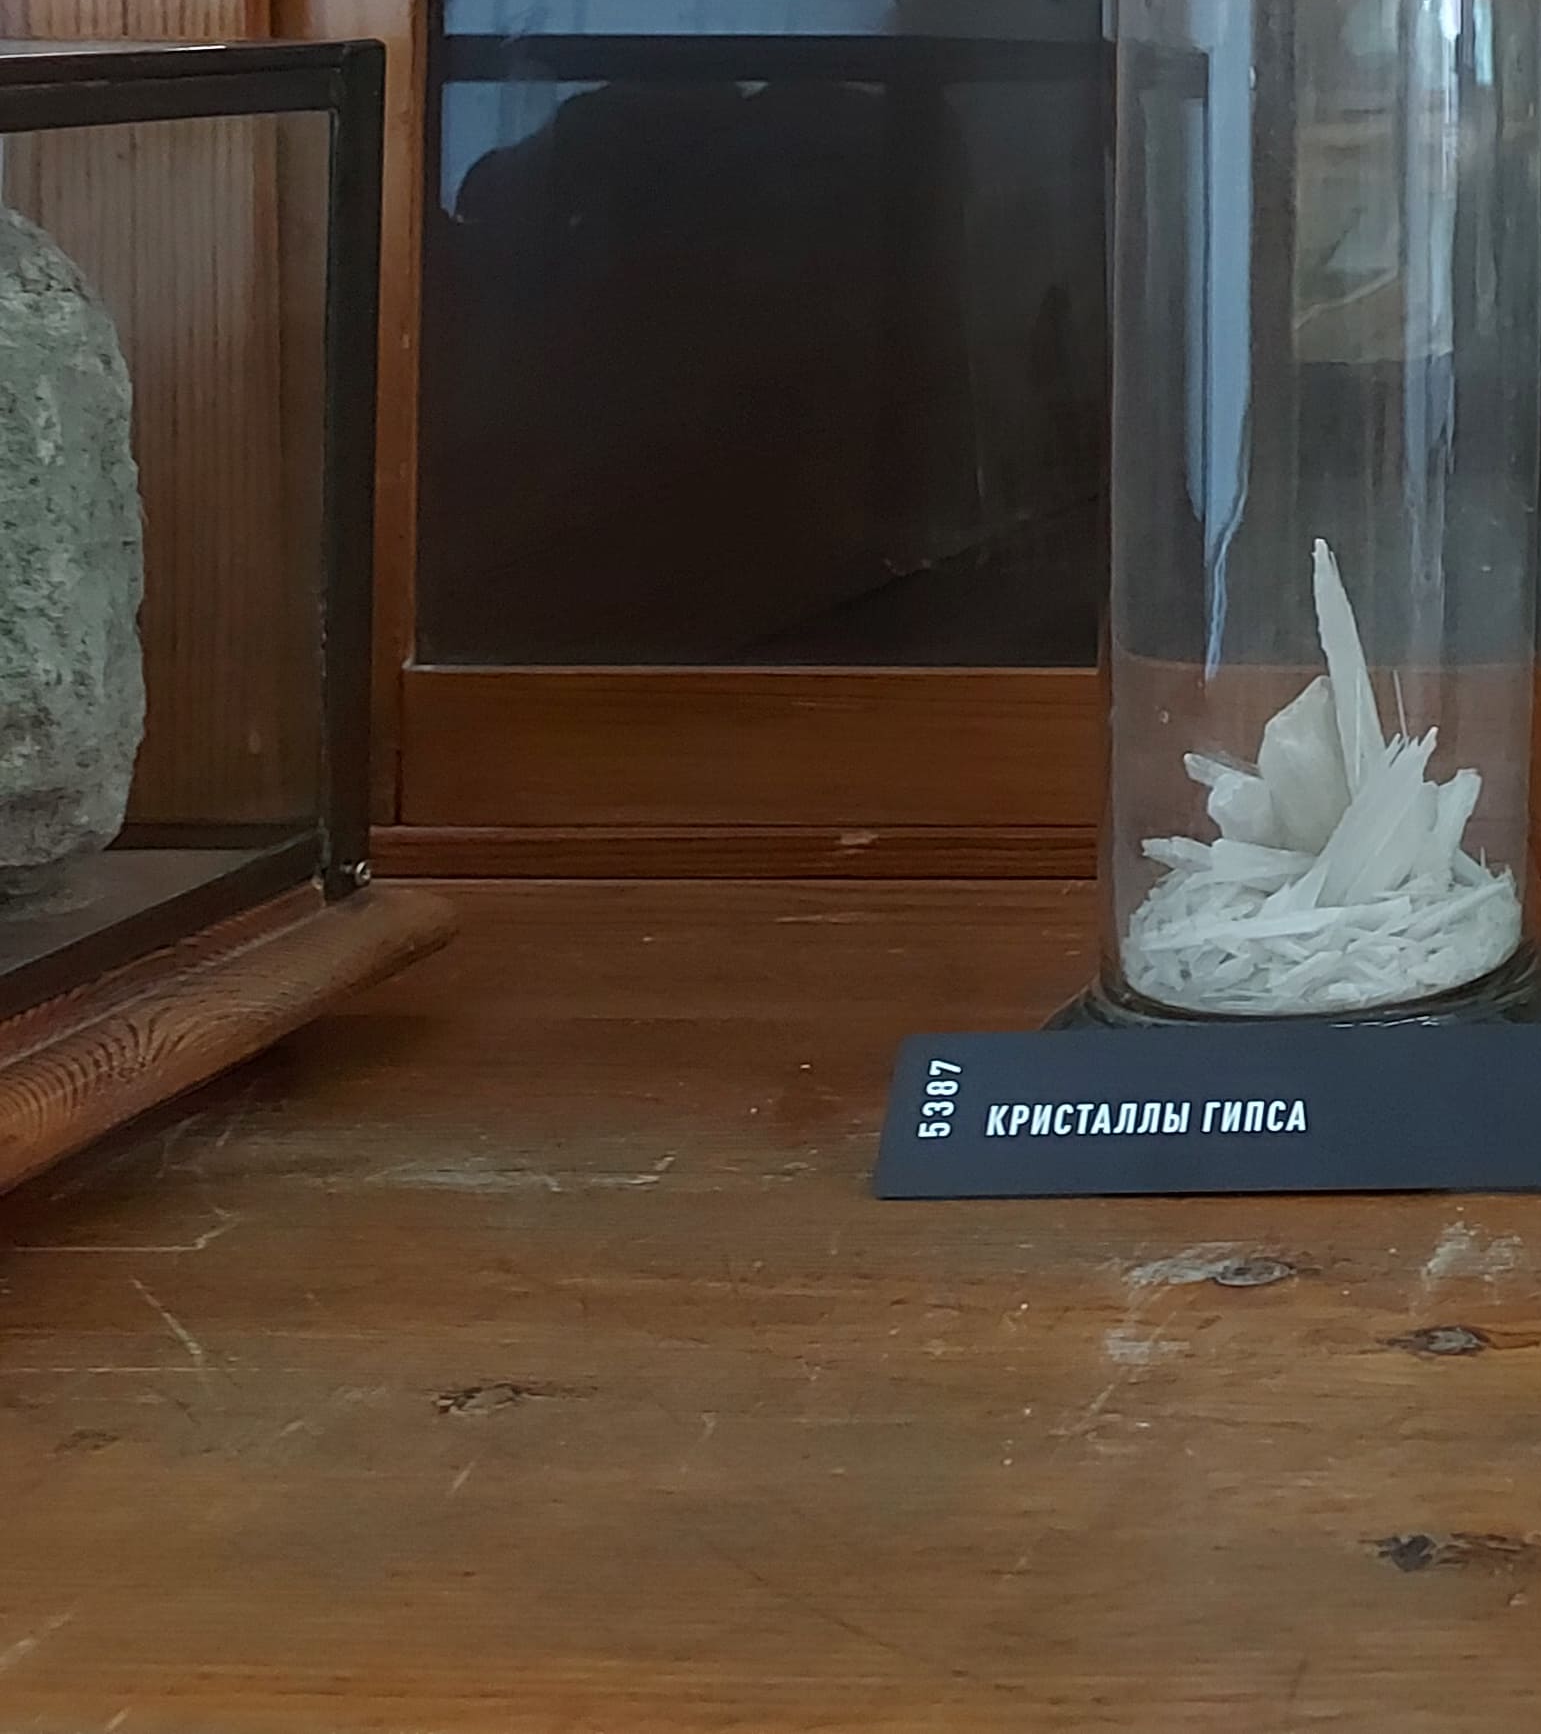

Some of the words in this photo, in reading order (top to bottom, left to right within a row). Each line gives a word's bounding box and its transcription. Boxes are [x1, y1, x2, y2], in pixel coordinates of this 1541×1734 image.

[918, 1061, 961, 1137] 5387
[986, 1103, 1190, 1135] КРИСТАЛЛЫ
[1202, 1101, 1305, 1132] ГИПСА
